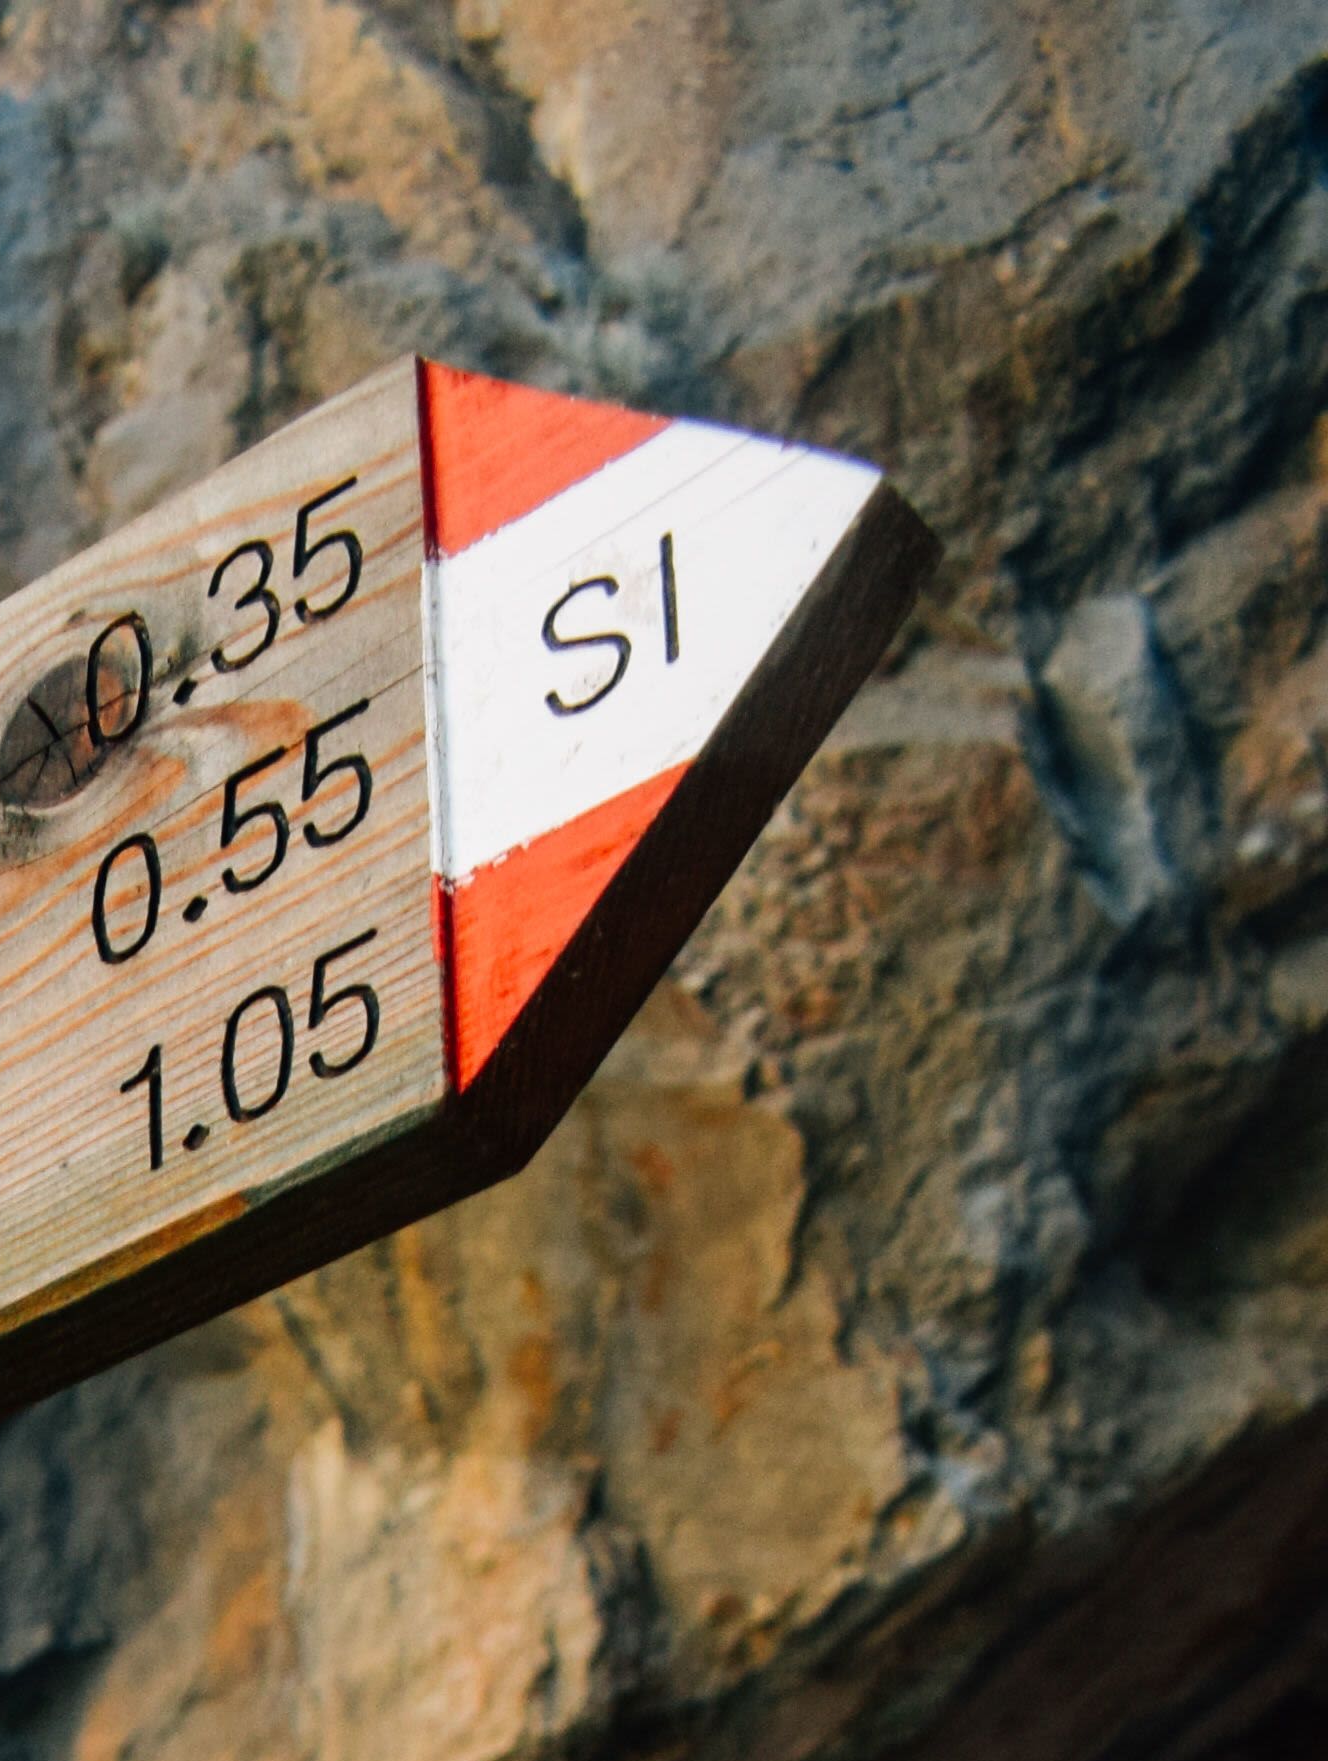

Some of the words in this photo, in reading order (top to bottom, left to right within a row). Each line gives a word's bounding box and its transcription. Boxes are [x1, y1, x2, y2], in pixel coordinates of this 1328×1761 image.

[87, 477, 362, 747] 0.35
[542, 531, 679, 716] SI
[92, 699, 371, 964] 0.55
[119, 929, 380, 1171] 1.05
